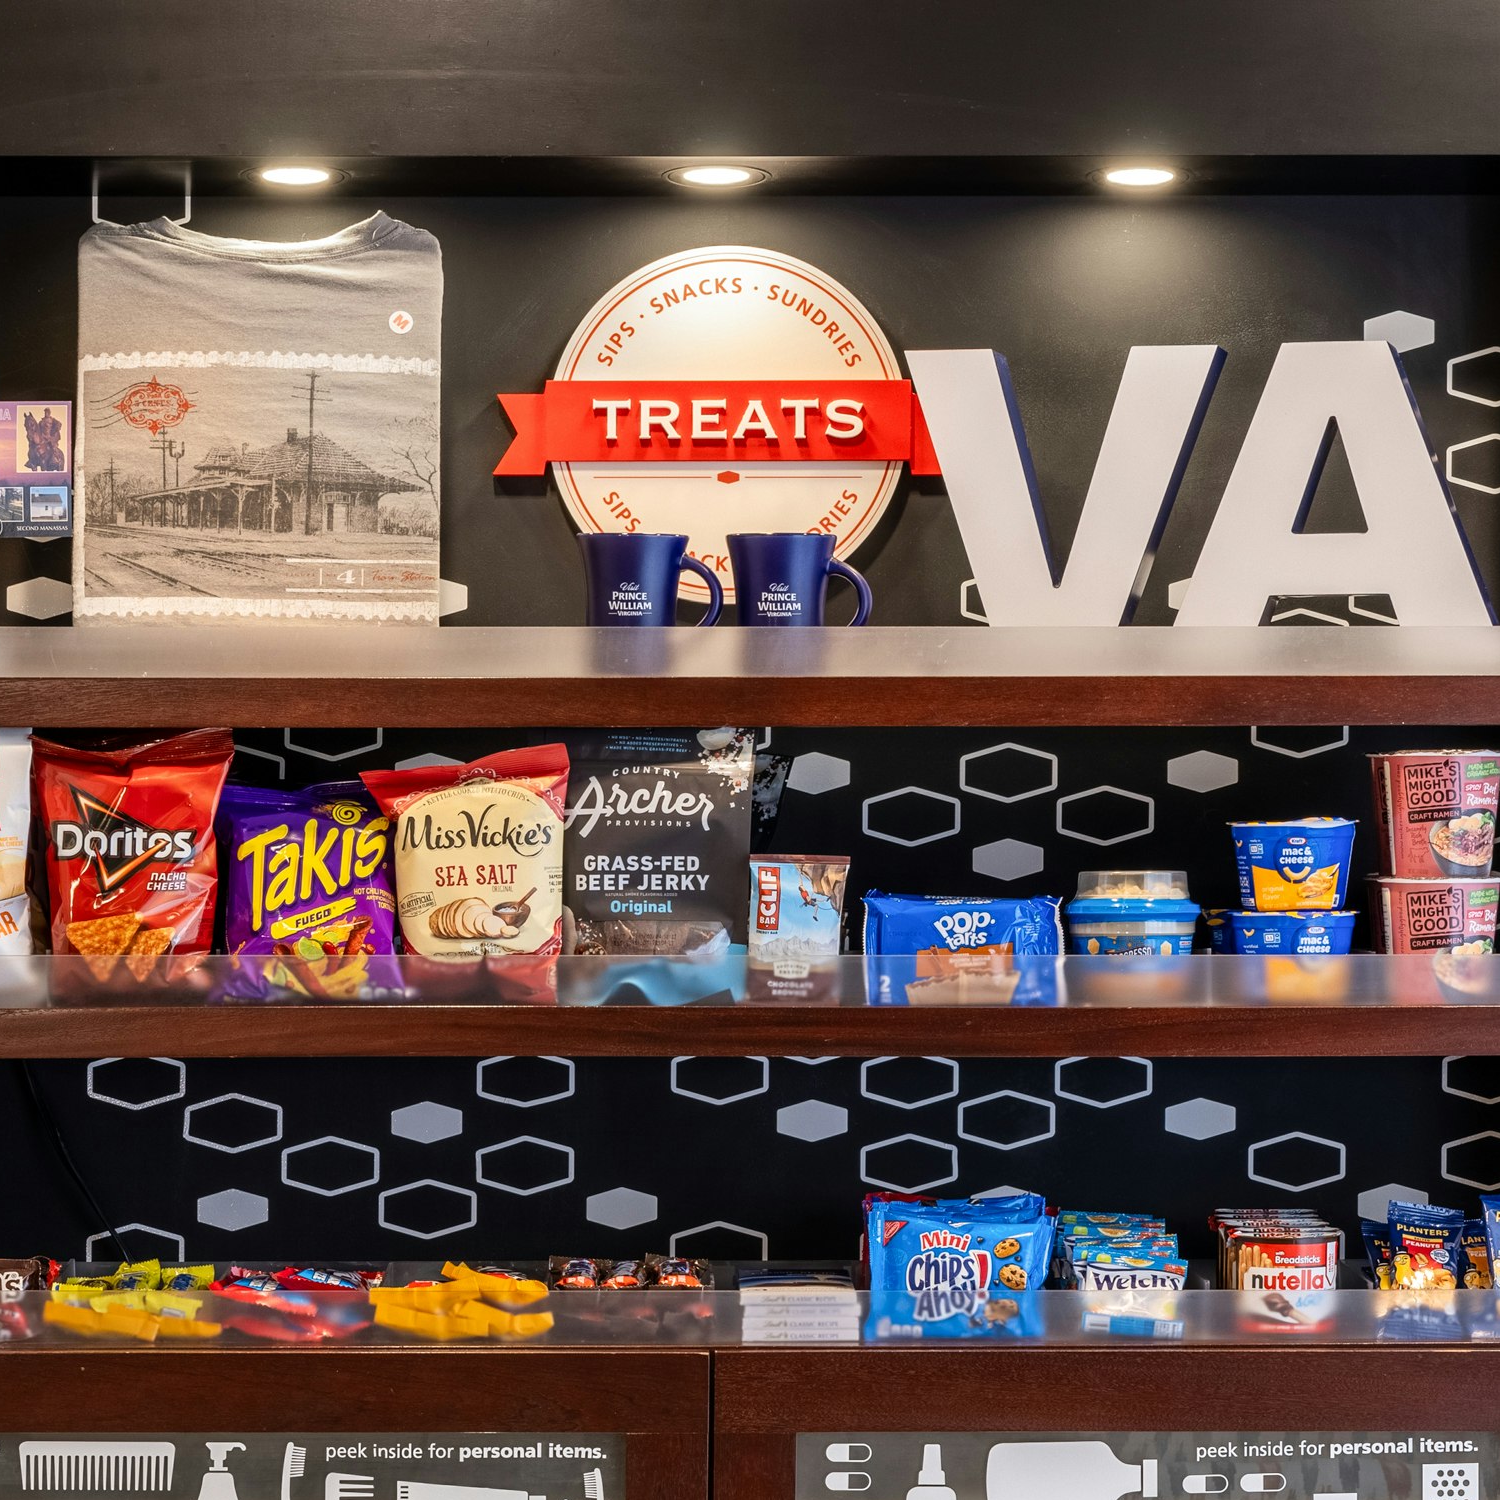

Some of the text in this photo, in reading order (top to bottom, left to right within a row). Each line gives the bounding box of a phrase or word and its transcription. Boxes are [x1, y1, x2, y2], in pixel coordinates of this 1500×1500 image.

[597, 278, 862, 368] SIPS SNACKS SUNDRIES
[592, 398, 864, 440] TREATS
[603, 491, 641, 532] SIPS
[612, 591, 648, 600] PRINCE
[761, 592, 797, 601] PRINCE
[608, 601, 652, 610] WILLIAM
[757, 601, 801, 611] WILLIAM
[612, 766, 681, 779] COUNTRY
[1408, 762, 1457, 780] MIKE'S
[1408, 778, 1457, 791] MIGHTY
[1410, 789, 1457, 805] GOOD
[565, 775, 715, 838] Archer
[1433, 810, 1460, 818] RAMEN
[606, 820, 691, 828] PROVISIONS
[56, 823, 195, 858] Doritos
[1282, 847, 1303, 856] mac
[583, 854, 700, 871] GRASS-FED
[150, 872, 187, 881] NACHO
[434, 864, 518, 887] SEA SALT
[575, 874, 630, 891] BEEF
[637, 874, 710, 891] JERKY
[146, 881, 187, 891] CHEESE
[492, 885, 514, 893] ORIGINAL
[759, 870, 778, 917] CLIF
[1410, 890, 1460, 906] MIKE'S
[610, 900, 673, 915] Original
[1411, 905, 1461, 918] MIGHTY
[295, 907, 331, 929] FUEGO
[1412, 916, 1460, 932] GOOD
[1300, 936, 1329, 945] mac &
[1436, 937, 1462, 946] RAMEN
[1397, 1223, 1450, 1237] PLANTERS
[920, 1230, 971, 1251] Mini
[1405, 1240, 1441, 1249] PEANUTS
[1274, 1255, 1321, 1264] Breadsticks
[1093, 1271, 1181, 1292] Welch's
[1252, 1269, 1324, 1290] nutella
[326, 1443, 607, 1462] peek inside for personal items.
[1196, 1437, 1478, 1461] peek inside for personal items.
